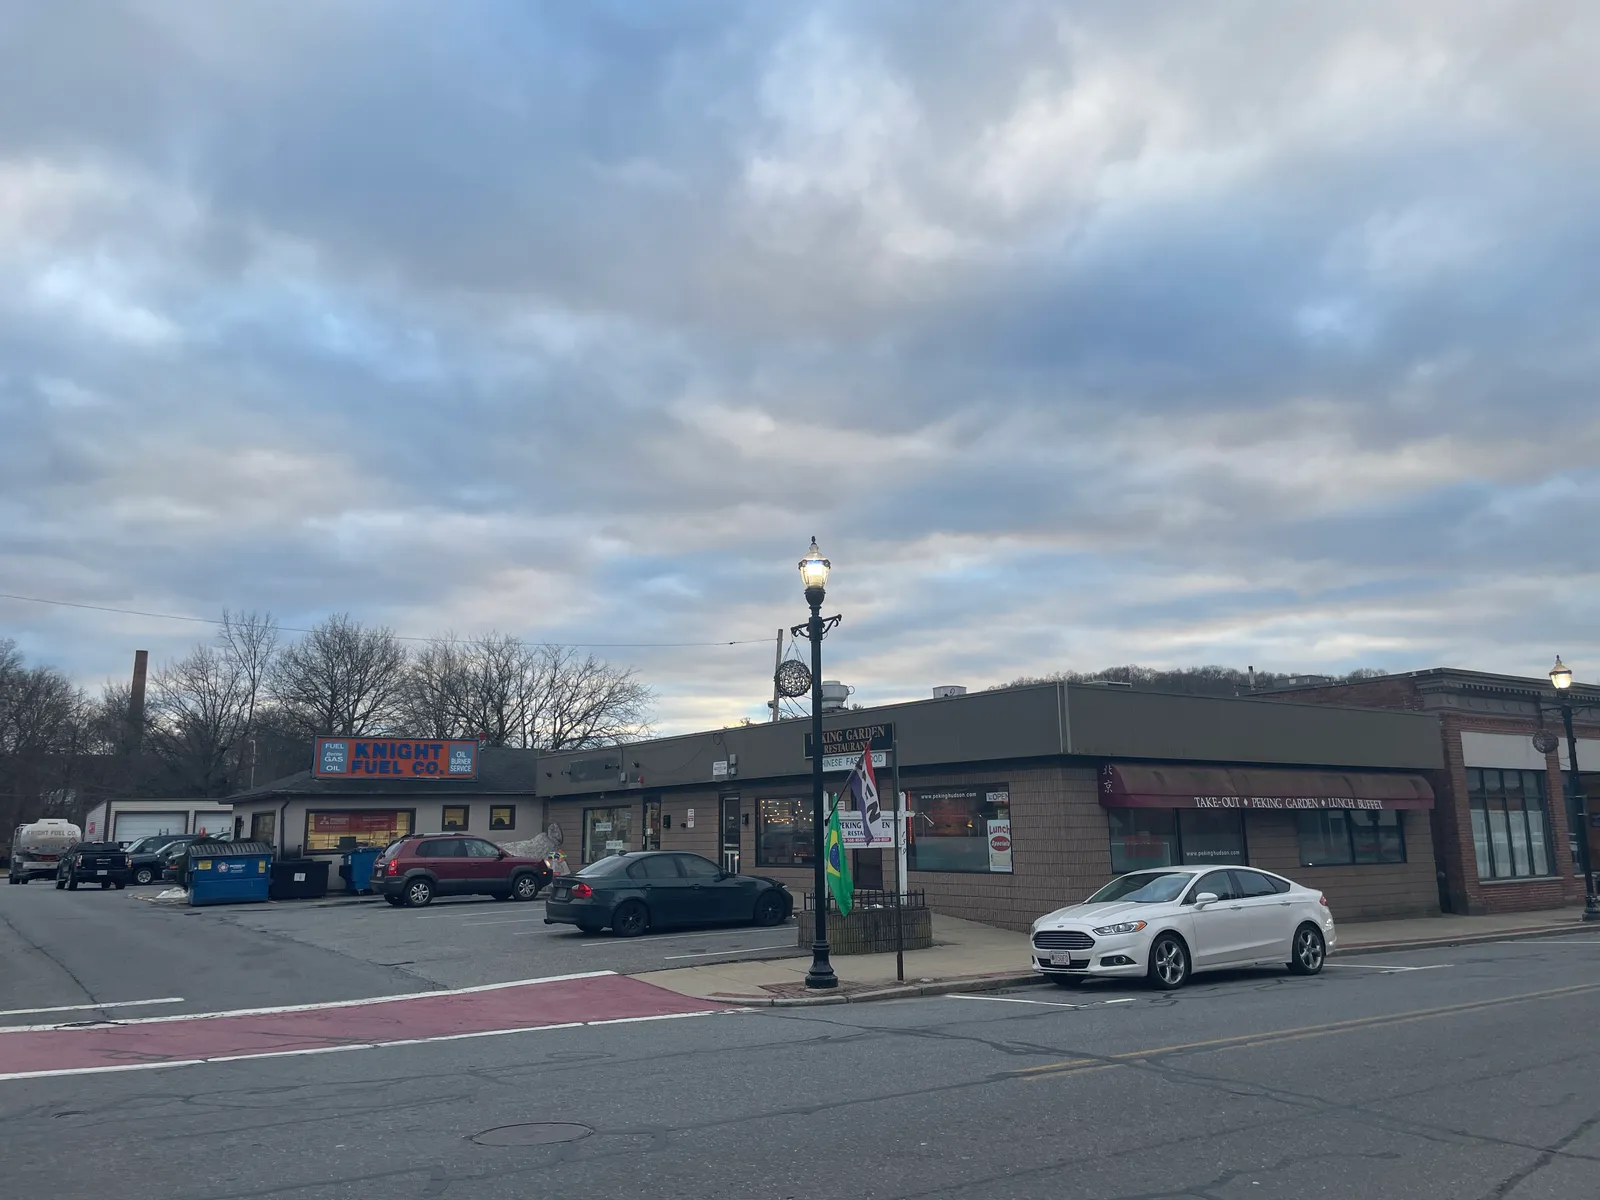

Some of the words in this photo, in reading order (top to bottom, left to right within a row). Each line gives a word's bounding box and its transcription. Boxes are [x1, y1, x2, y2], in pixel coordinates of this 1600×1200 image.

[846, 726, 885, 741] GARDEN
[355, 742, 444, 759] KNIGHT
[325, 764, 341, 772] OIL
[351, 760, 403, 774] FUEL
[412, 761, 445, 775] CO.
[1194, 796, 1241, 808] TAKE-OUT
[1251, 797, 1282, 808] PEKING
[1285, 798, 1319, 808] GARDEN
[1328, 798, 1355, 809] LUNCH
[1357, 799, 1383, 810] BUFFET
[989, 825, 1010, 835] Lunch
